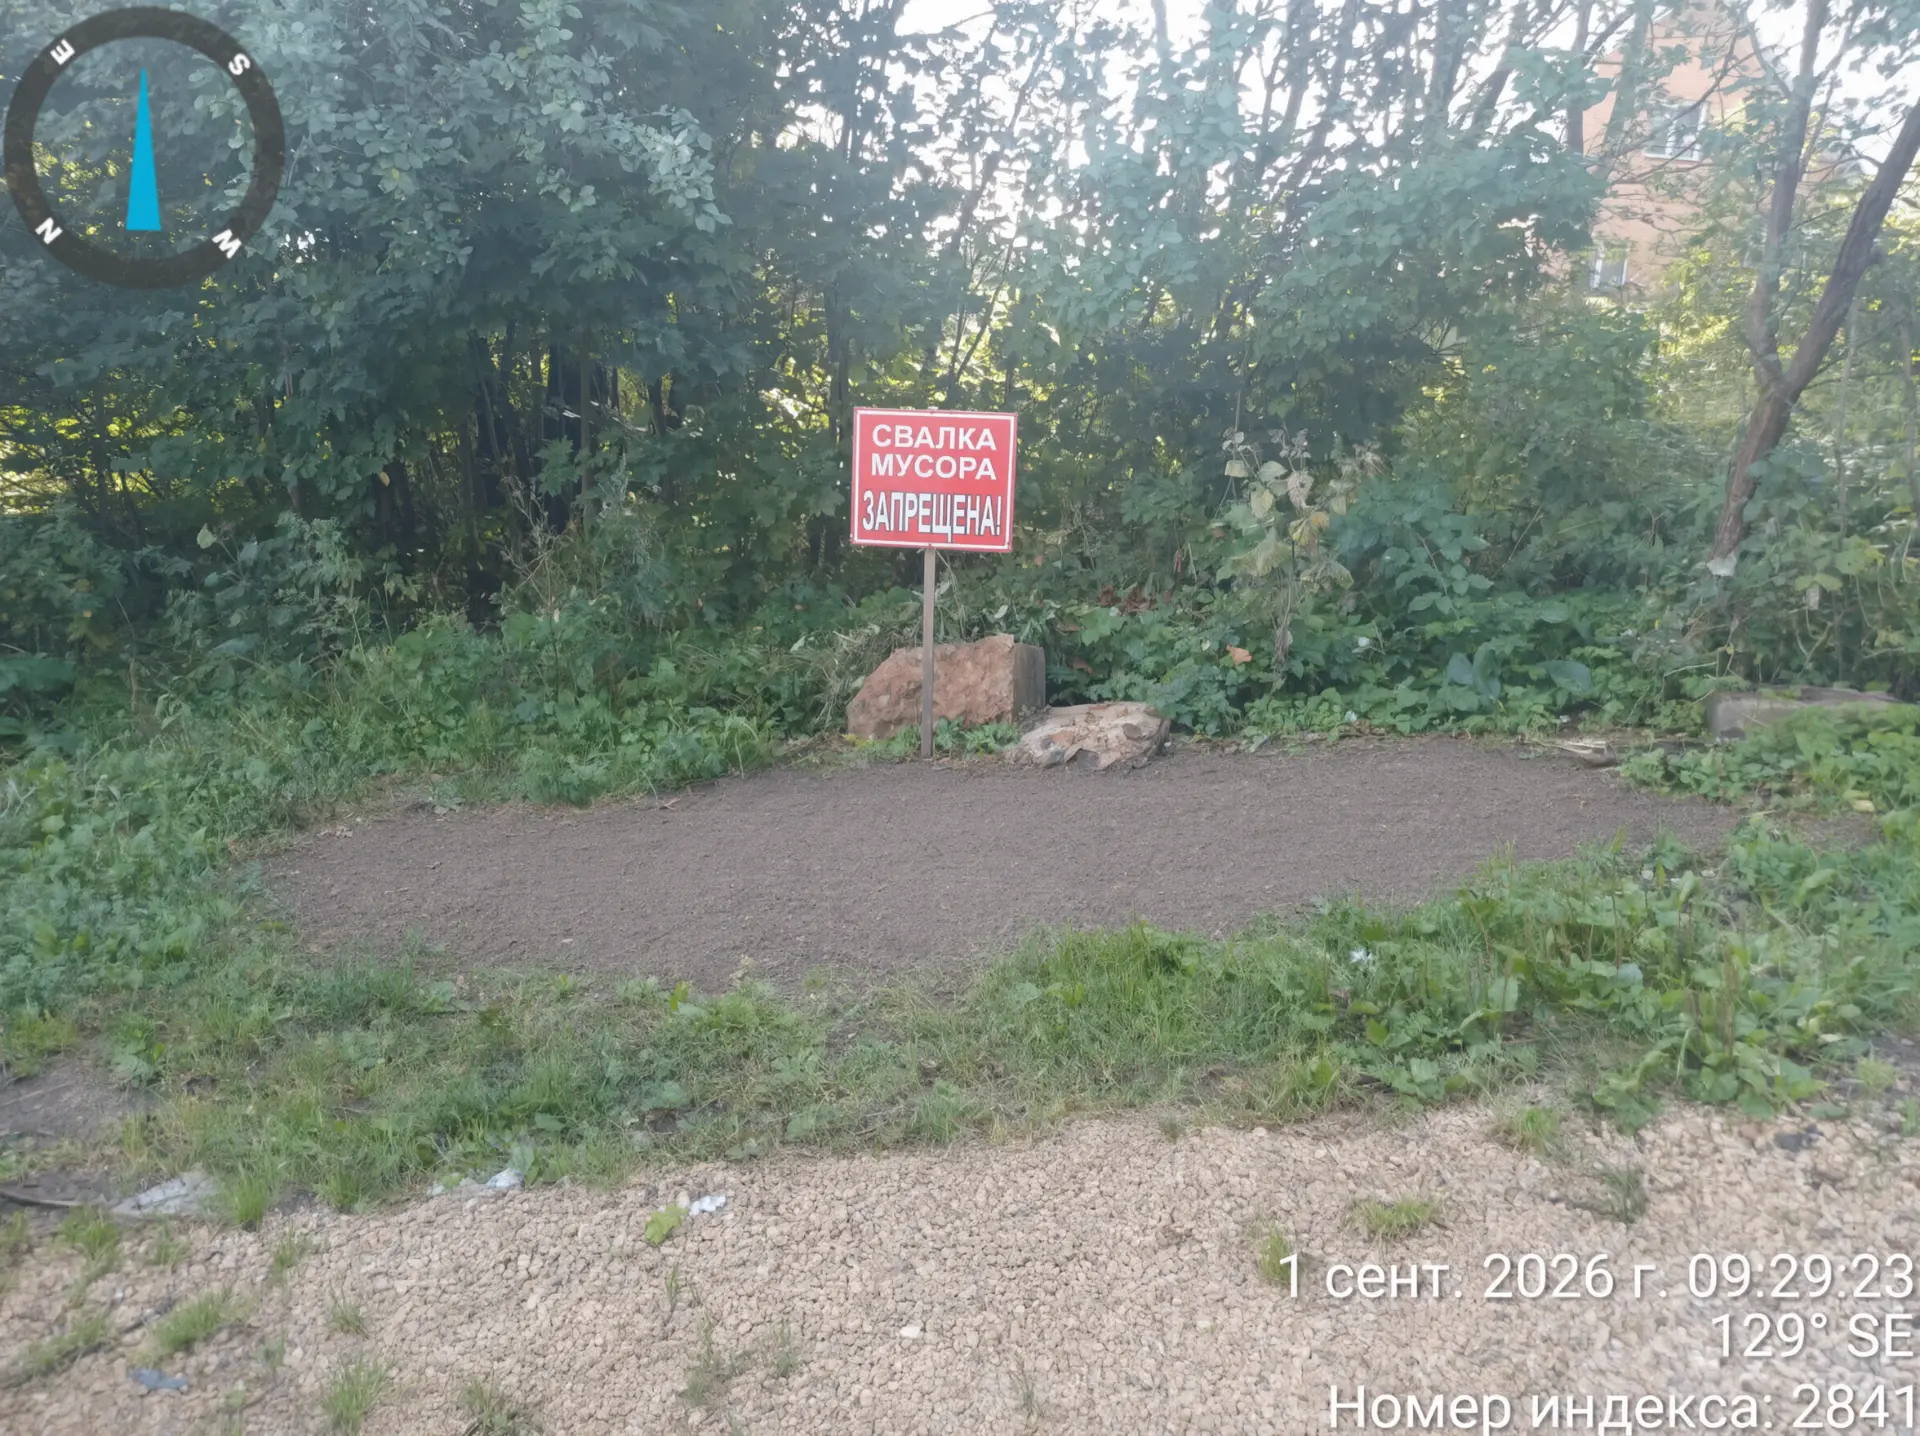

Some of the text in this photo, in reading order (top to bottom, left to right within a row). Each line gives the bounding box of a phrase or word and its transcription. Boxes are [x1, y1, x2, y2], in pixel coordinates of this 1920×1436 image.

[872, 424, 997, 451] СВАЛКА
[871, 453, 997, 480] МУСОРА
[862, 490, 1002, 543] ЗАПРЕЩЕНА!
